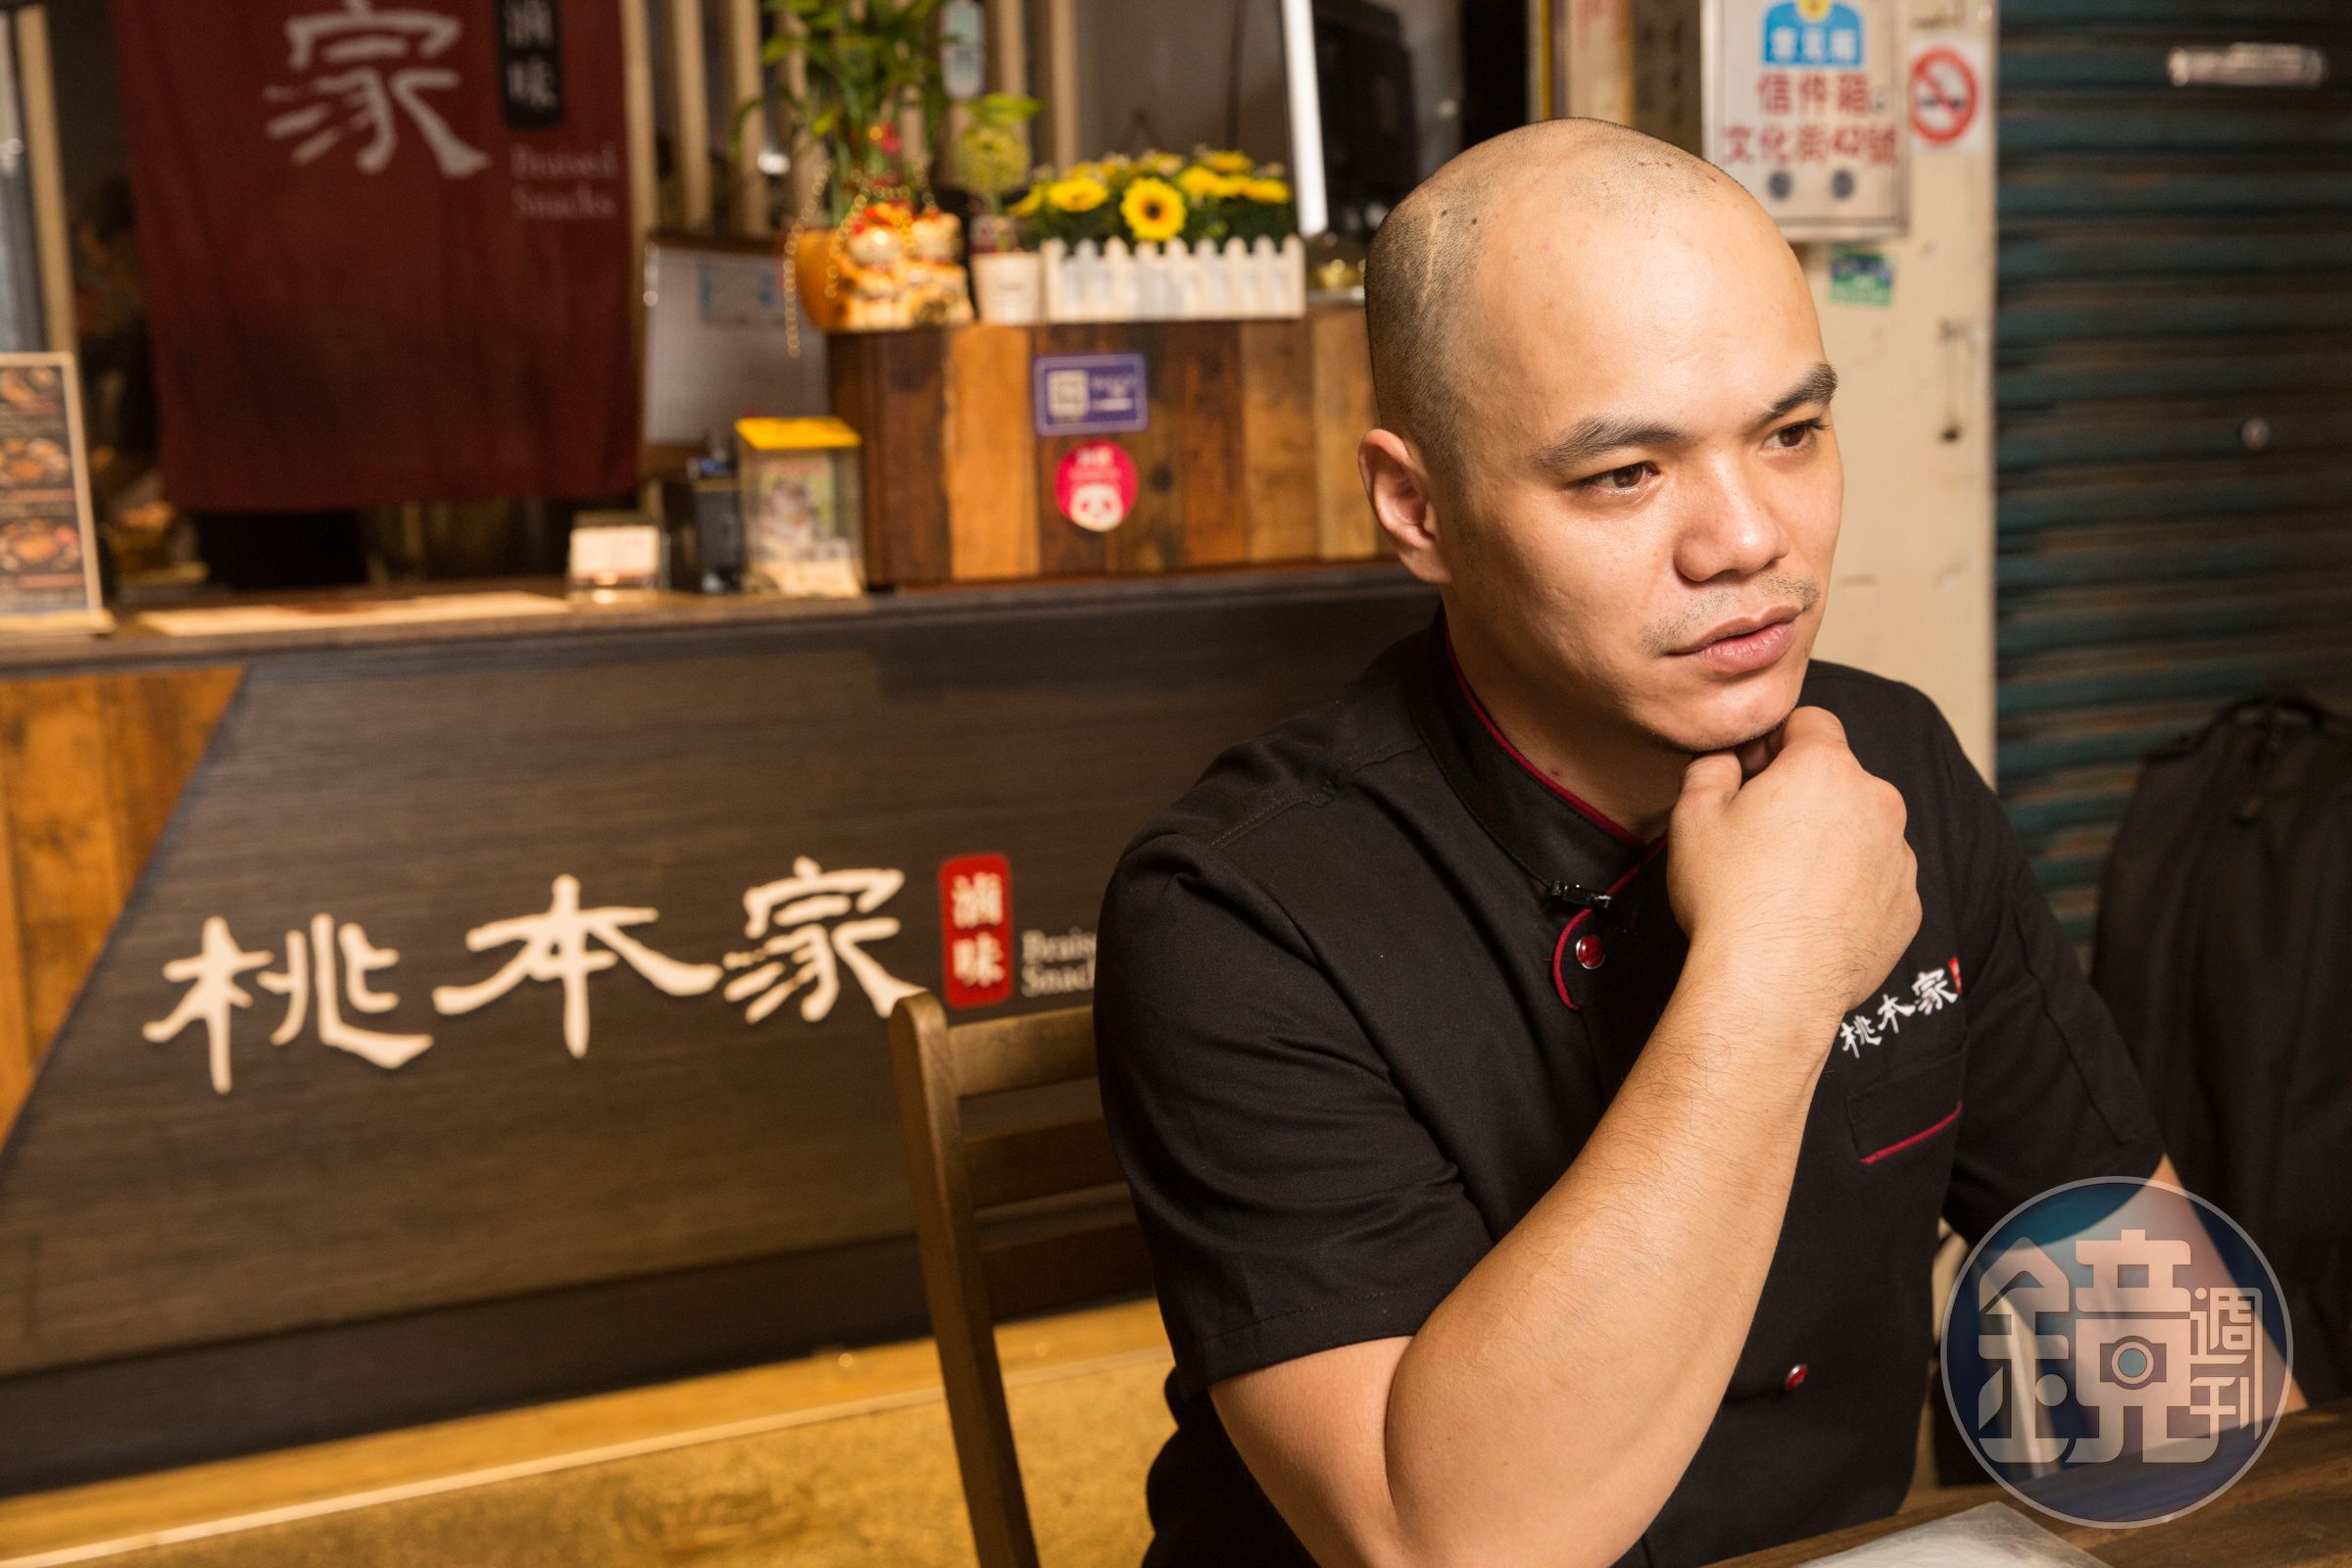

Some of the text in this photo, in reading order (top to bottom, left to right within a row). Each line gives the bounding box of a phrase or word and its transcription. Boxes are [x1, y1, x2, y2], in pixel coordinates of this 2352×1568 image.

[265, 0, 490, 177] 家
[141, 857, 927, 1094] 桃本家
[950, 871, 1004, 987] 滷味
[1839, 968, 1958, 1058] 桃本家
